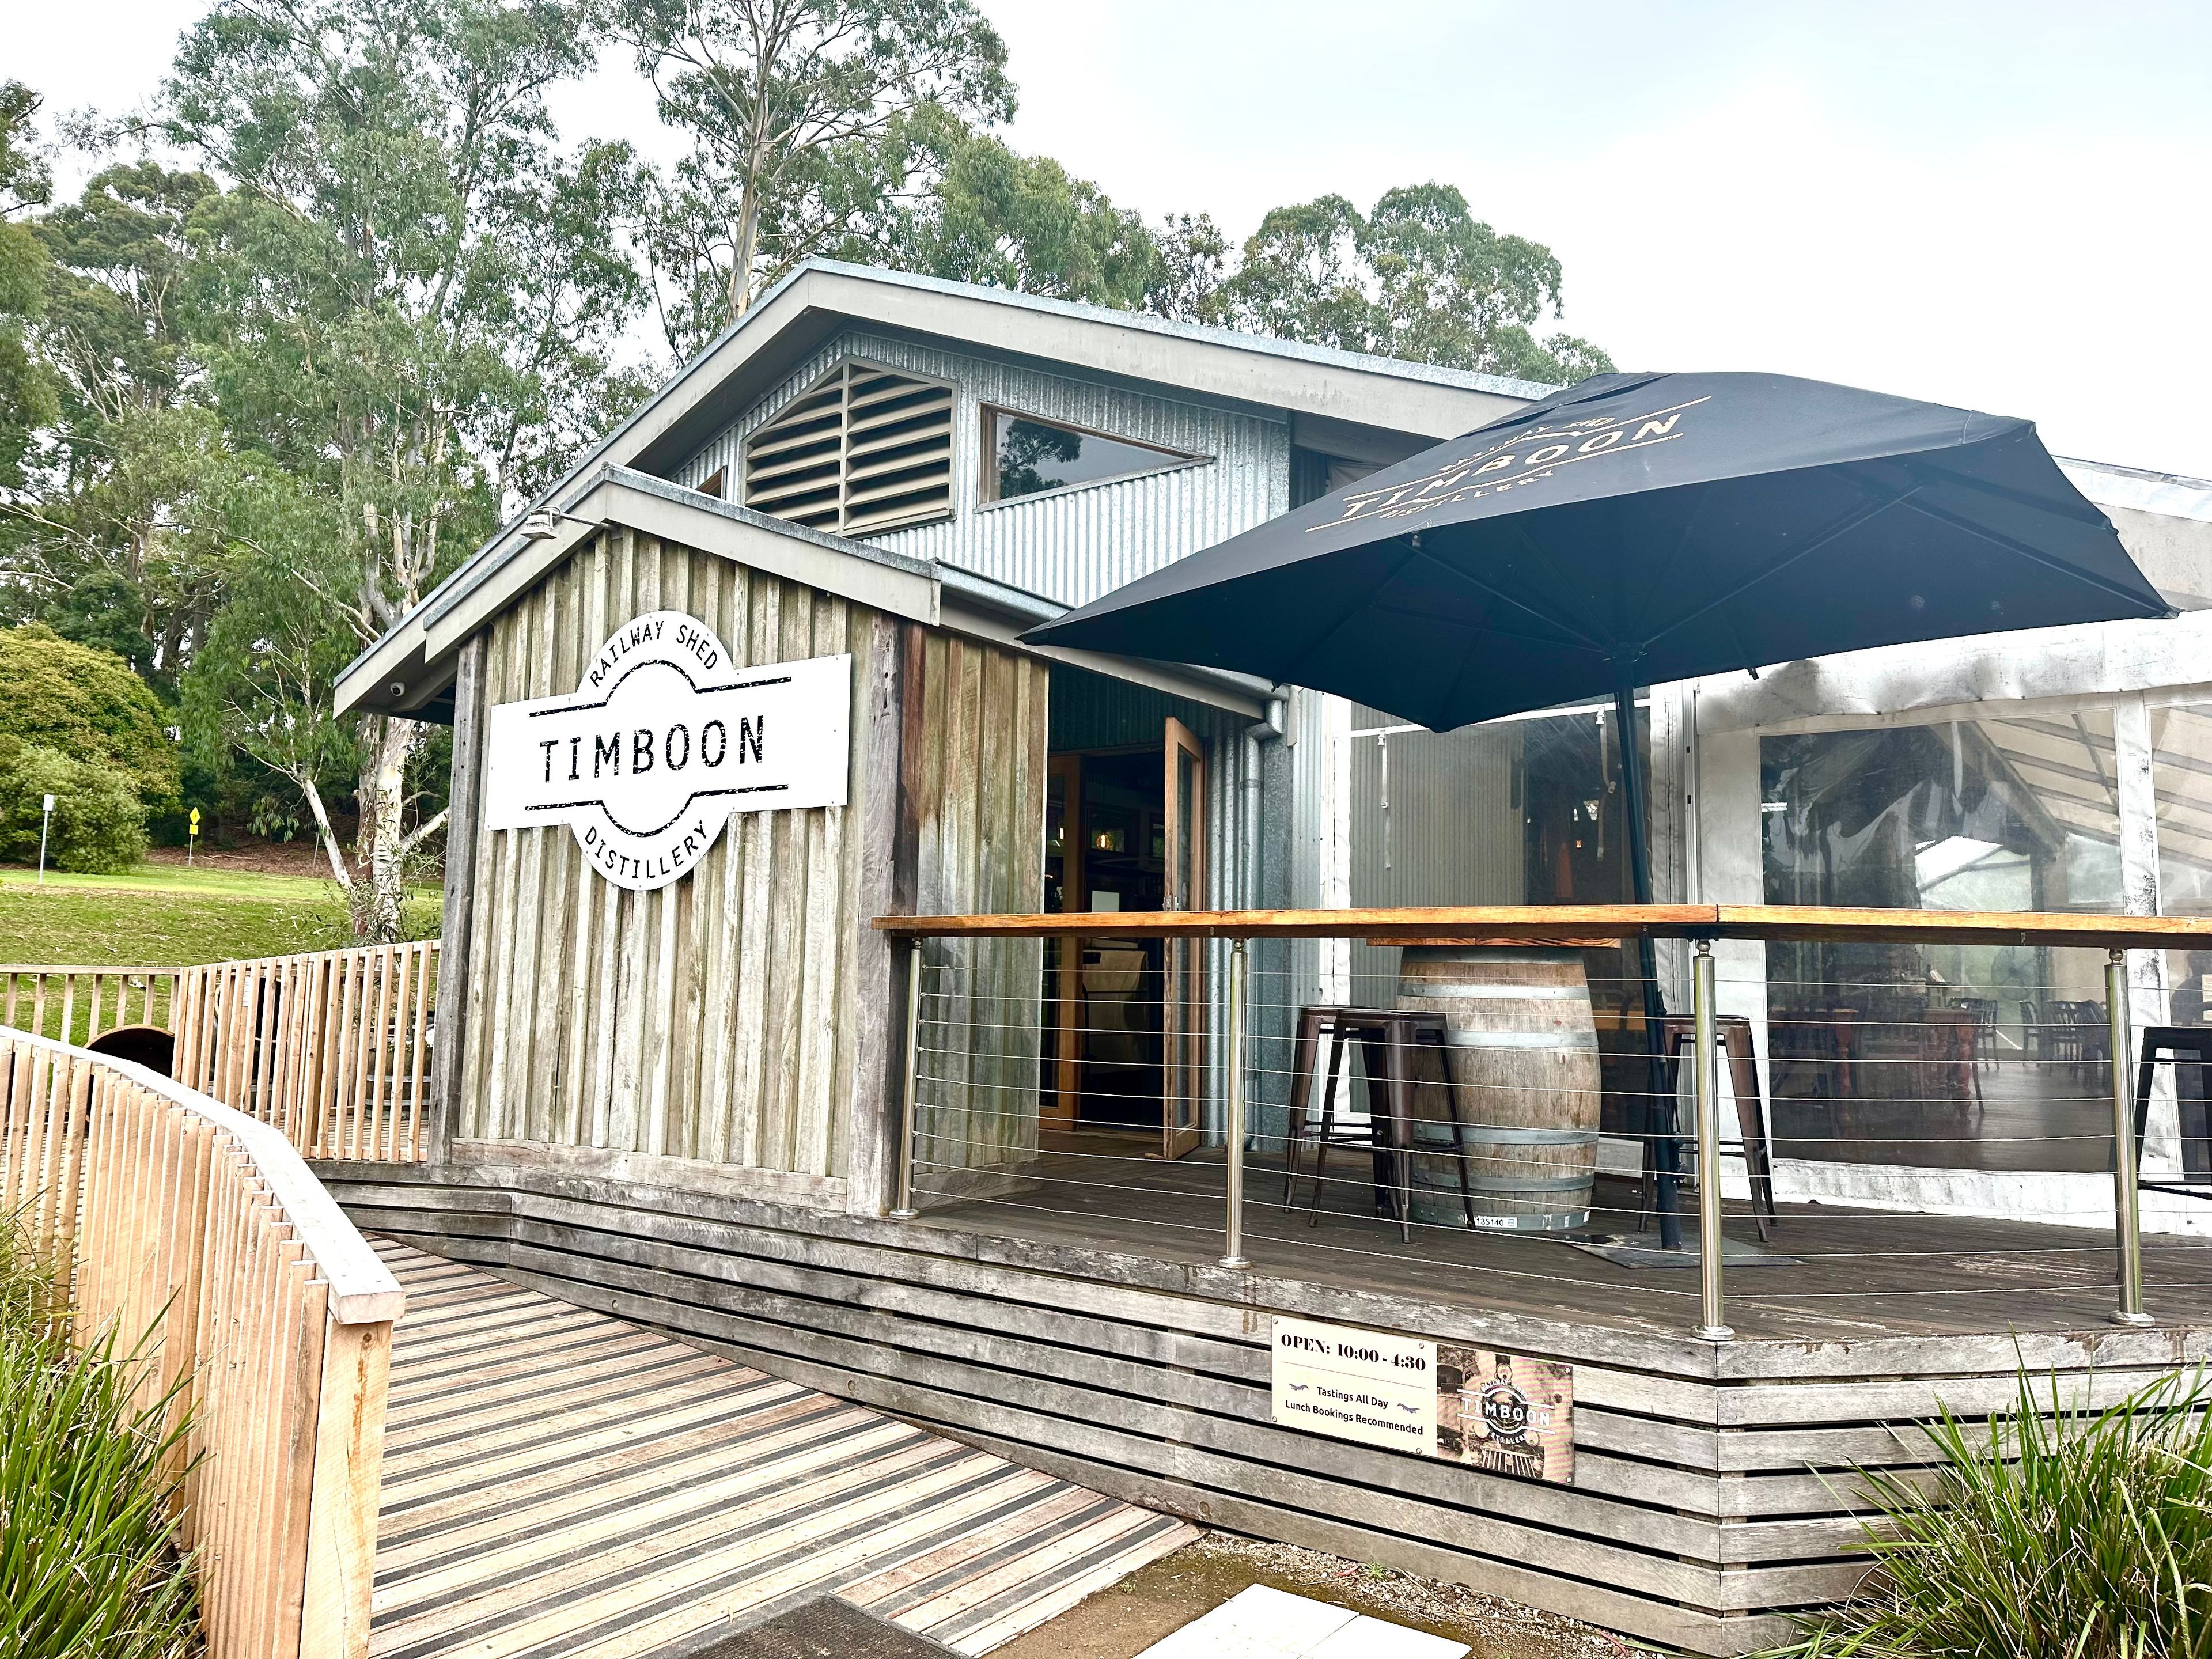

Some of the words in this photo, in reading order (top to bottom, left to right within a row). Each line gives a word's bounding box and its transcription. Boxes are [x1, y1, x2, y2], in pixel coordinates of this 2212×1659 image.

[1342, 413, 1681, 517] TIMBOON
[589, 620, 665, 688] RAILWAY
[676, 624, 718, 671] SHED
[539, 715, 764, 783] TIMBOON
[584, 819, 707, 880] DISTILLERY
[1476, 1217, 1504, 1226] 135140
[1281, 1334, 1330, 1354] OPEN:
[1337, 1343, 1379, 1363] 10:00
[1390, 1354, 1426, 1371] 4:30
[1317, 1386, 1353, 1402] Tastings
[1355, 1394, 1368, 1404] All
[1371, 1397, 1388, 1409] Day
[1461, 1397, 1551, 1426] TIMBOON
[1285, 1400, 1310, 1412] Lunch
[1313, 1405, 1353, 1422] Bookings
[1355, 1414, 1423, 1435] Recommended
